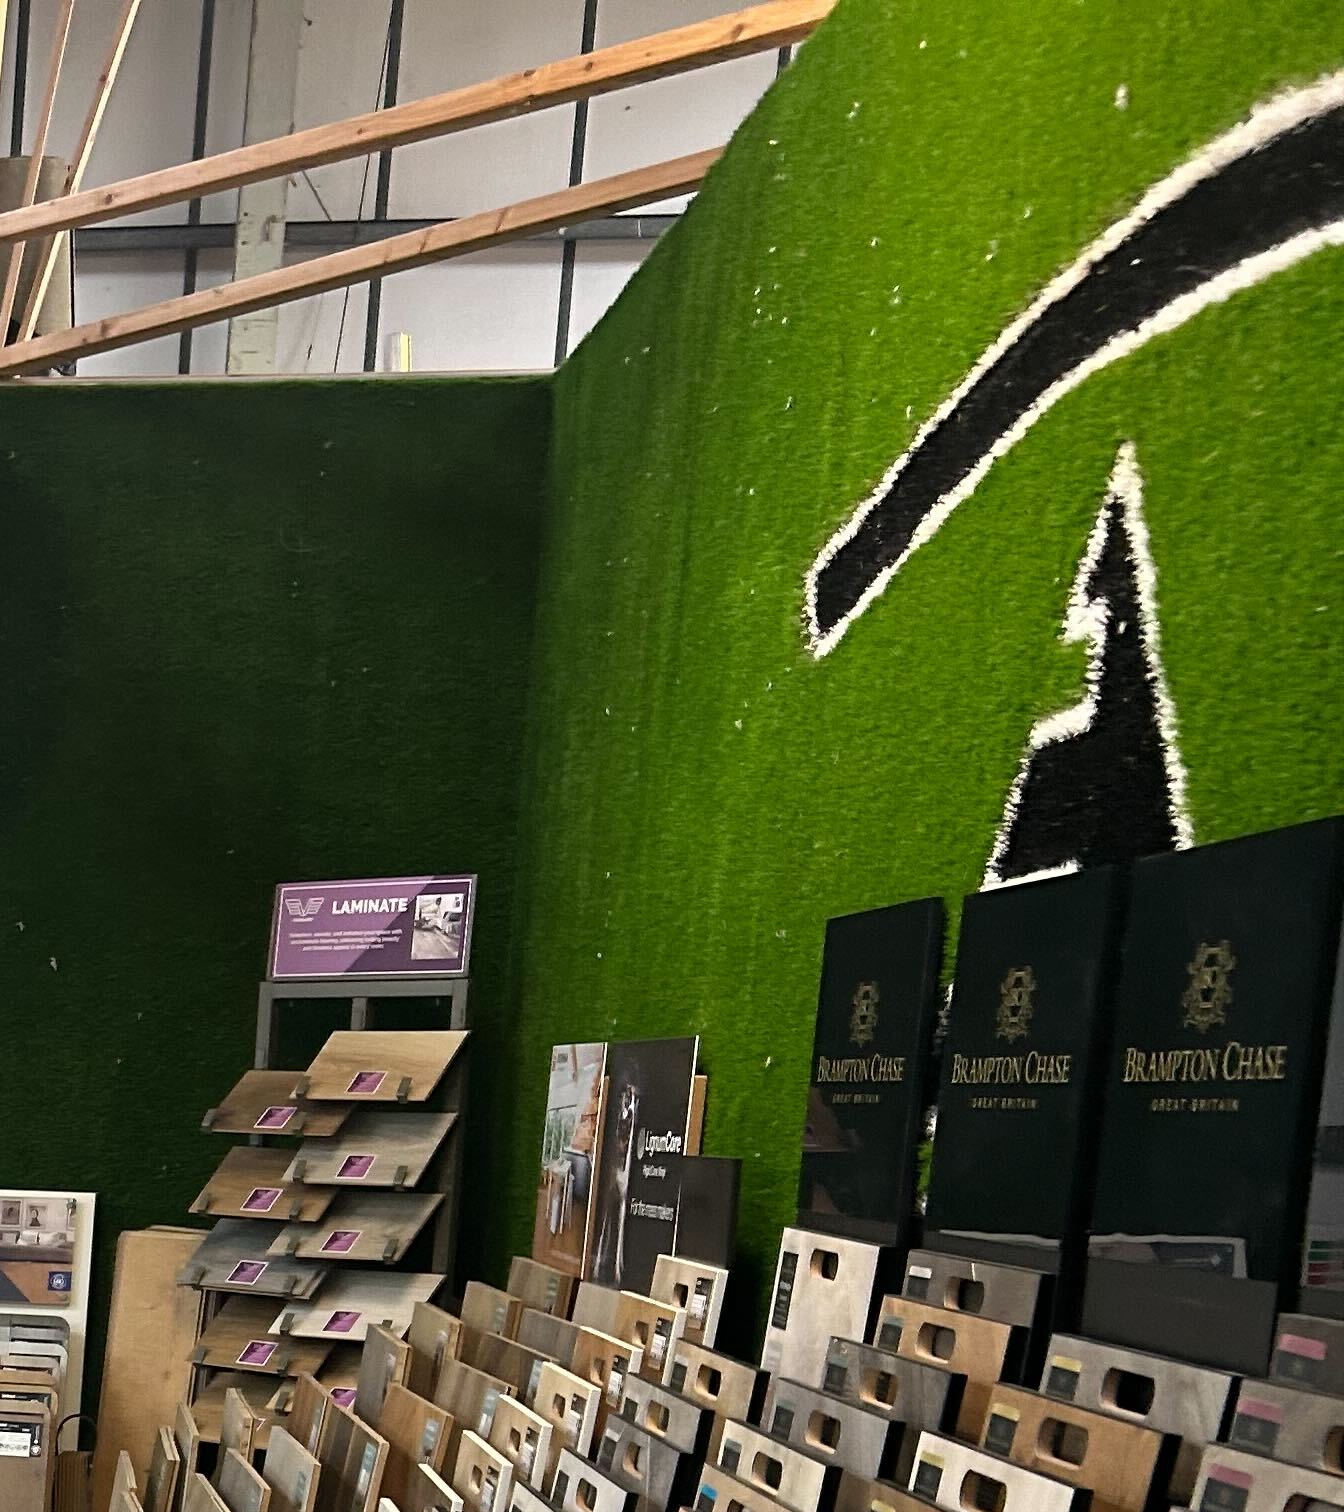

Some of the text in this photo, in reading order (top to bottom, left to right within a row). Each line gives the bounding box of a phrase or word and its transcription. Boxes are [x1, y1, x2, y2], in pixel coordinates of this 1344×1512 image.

[331, 897, 409, 915] LAMINATE
[816, 1053, 906, 1082] BRAMPTON CHASE
[951, 1050, 1072, 1084] BRAMPTON CHASE
[1123, 1041, 1288, 1082] BRAMPTON CHASE
